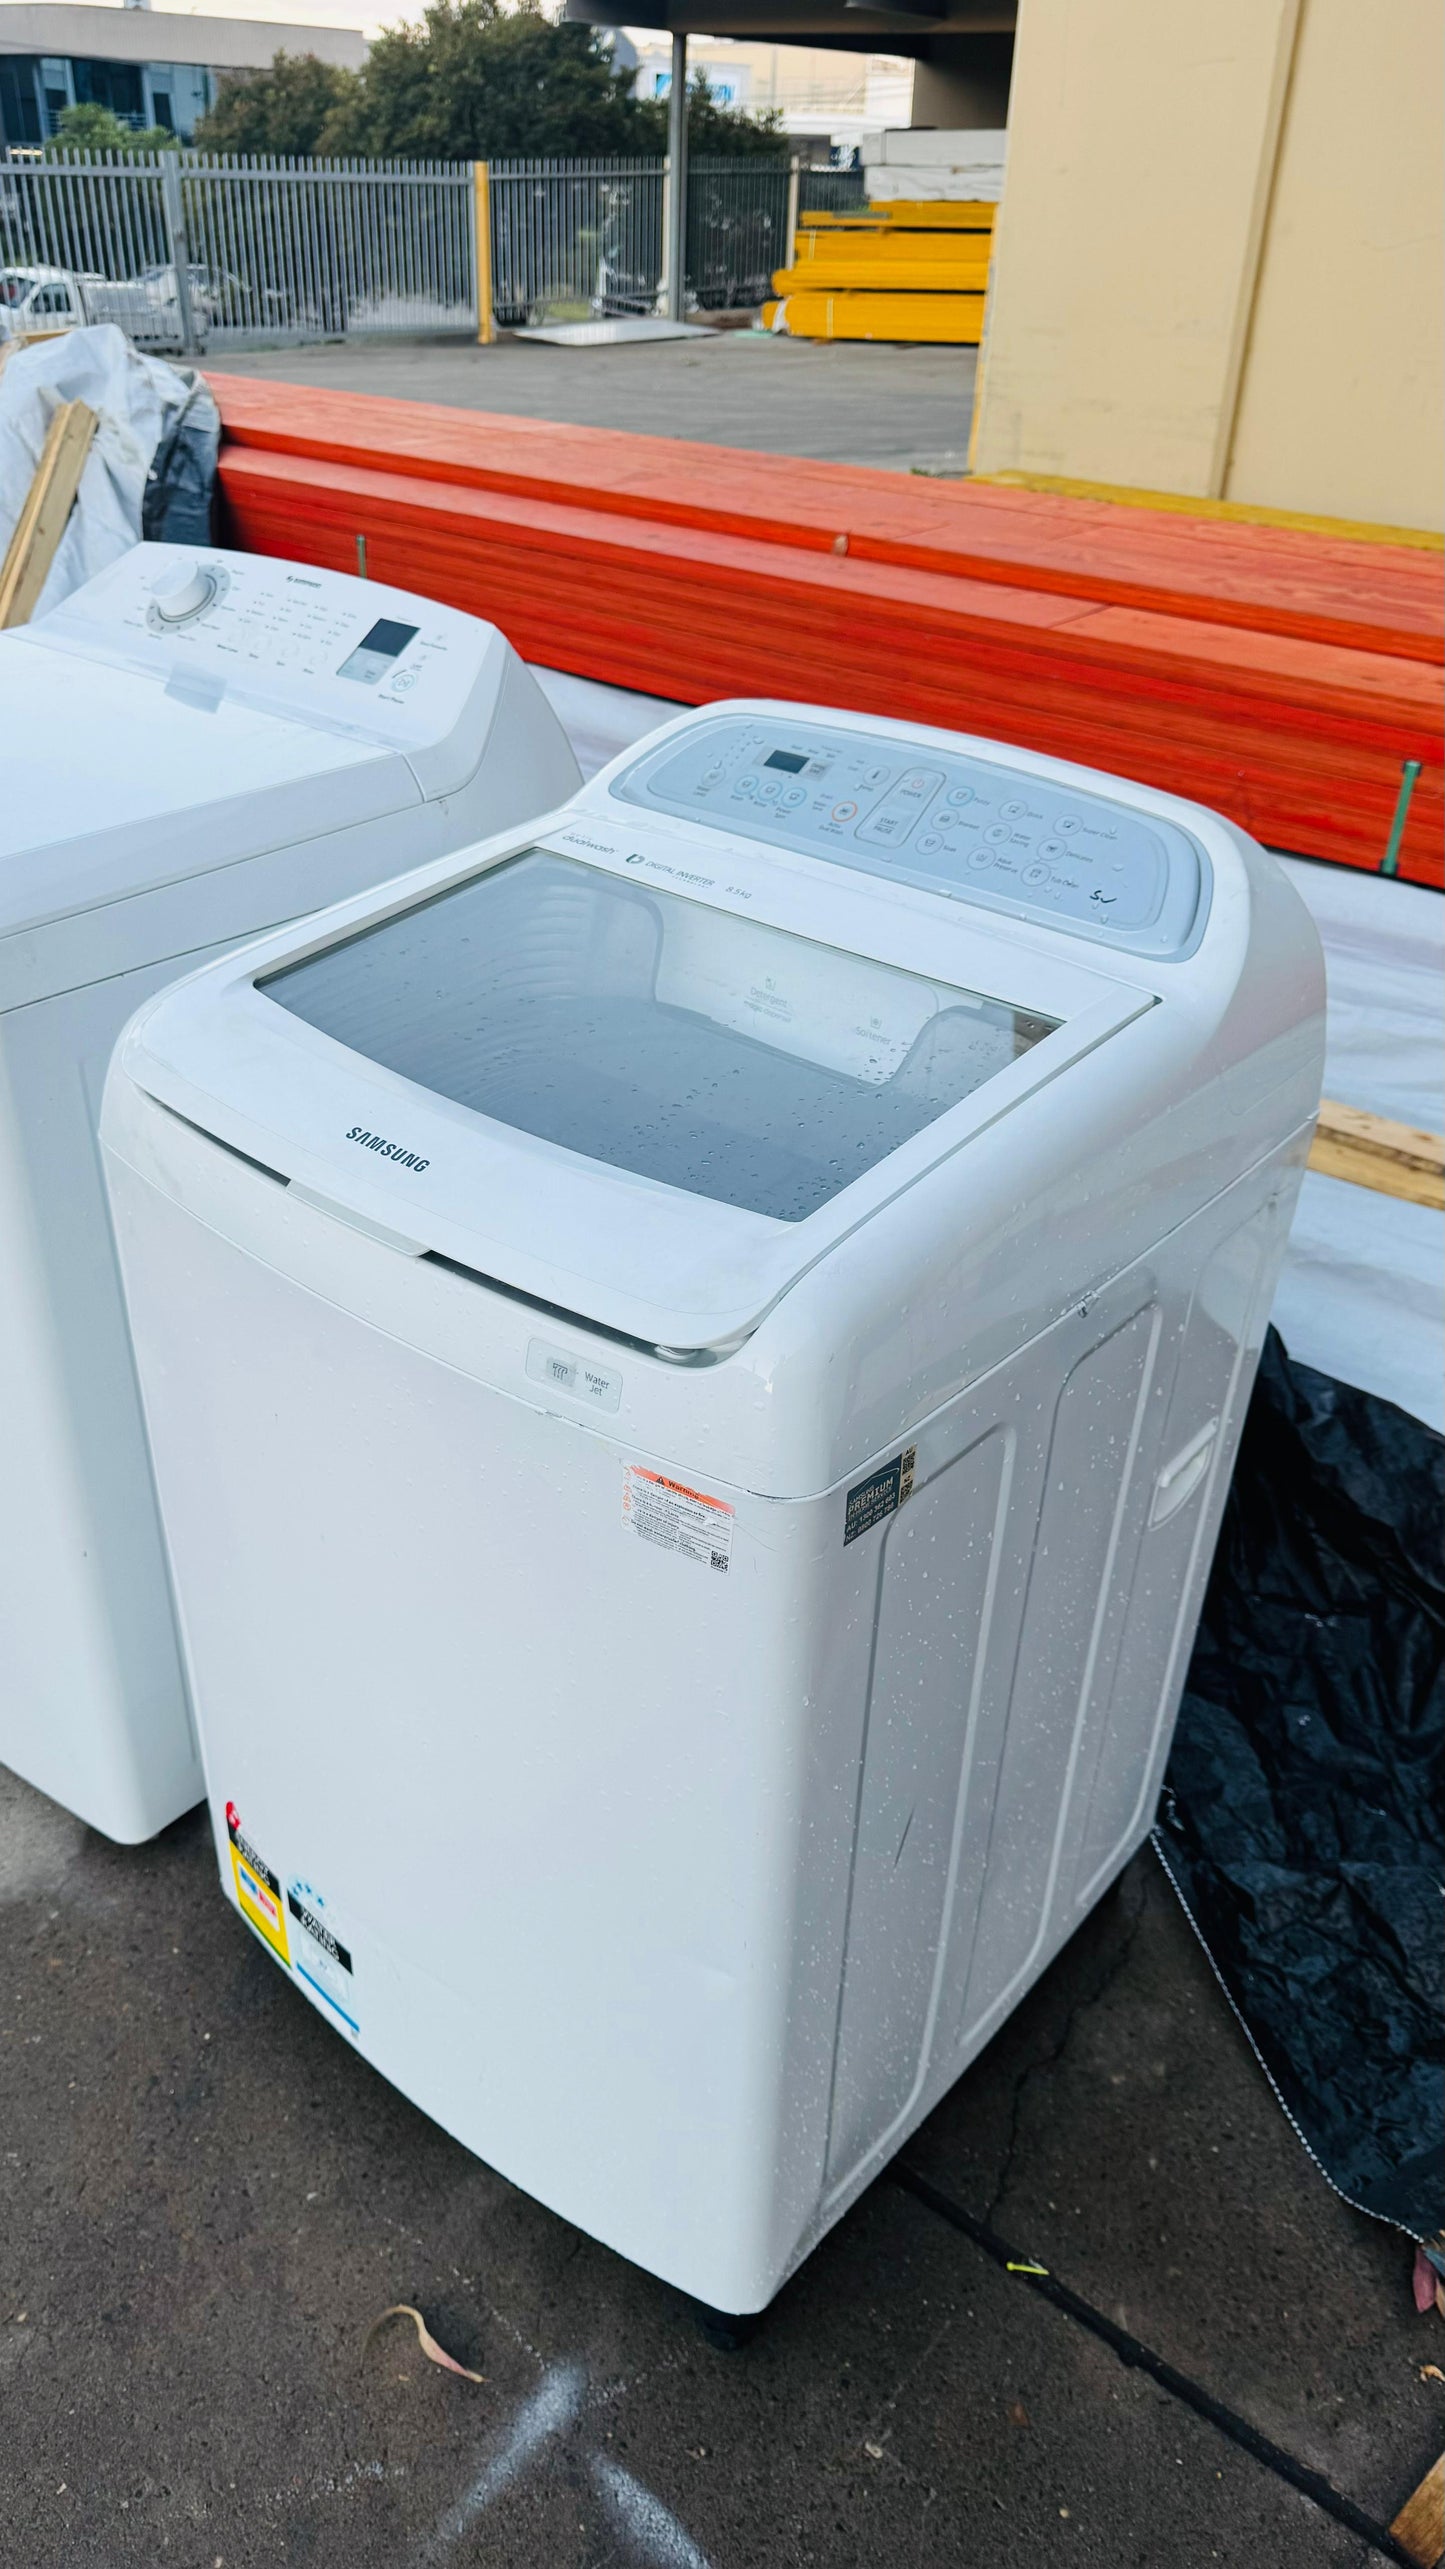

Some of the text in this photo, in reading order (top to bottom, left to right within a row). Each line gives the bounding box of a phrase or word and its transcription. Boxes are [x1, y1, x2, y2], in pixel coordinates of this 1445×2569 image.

[645, 861, 677, 875] DIGITAL
[676, 870, 716, 886] INVERTER
[855, 1026, 893, 1047] Softener
[345, 1127, 431, 1172] SAMSUNG
[584, 1371, 610, 1389] Water
[589, 1385, 603, 1397] Jet
[668, 1480, 700, 1500] Warning
[848, 1476, 894, 1515] PREMIUM
